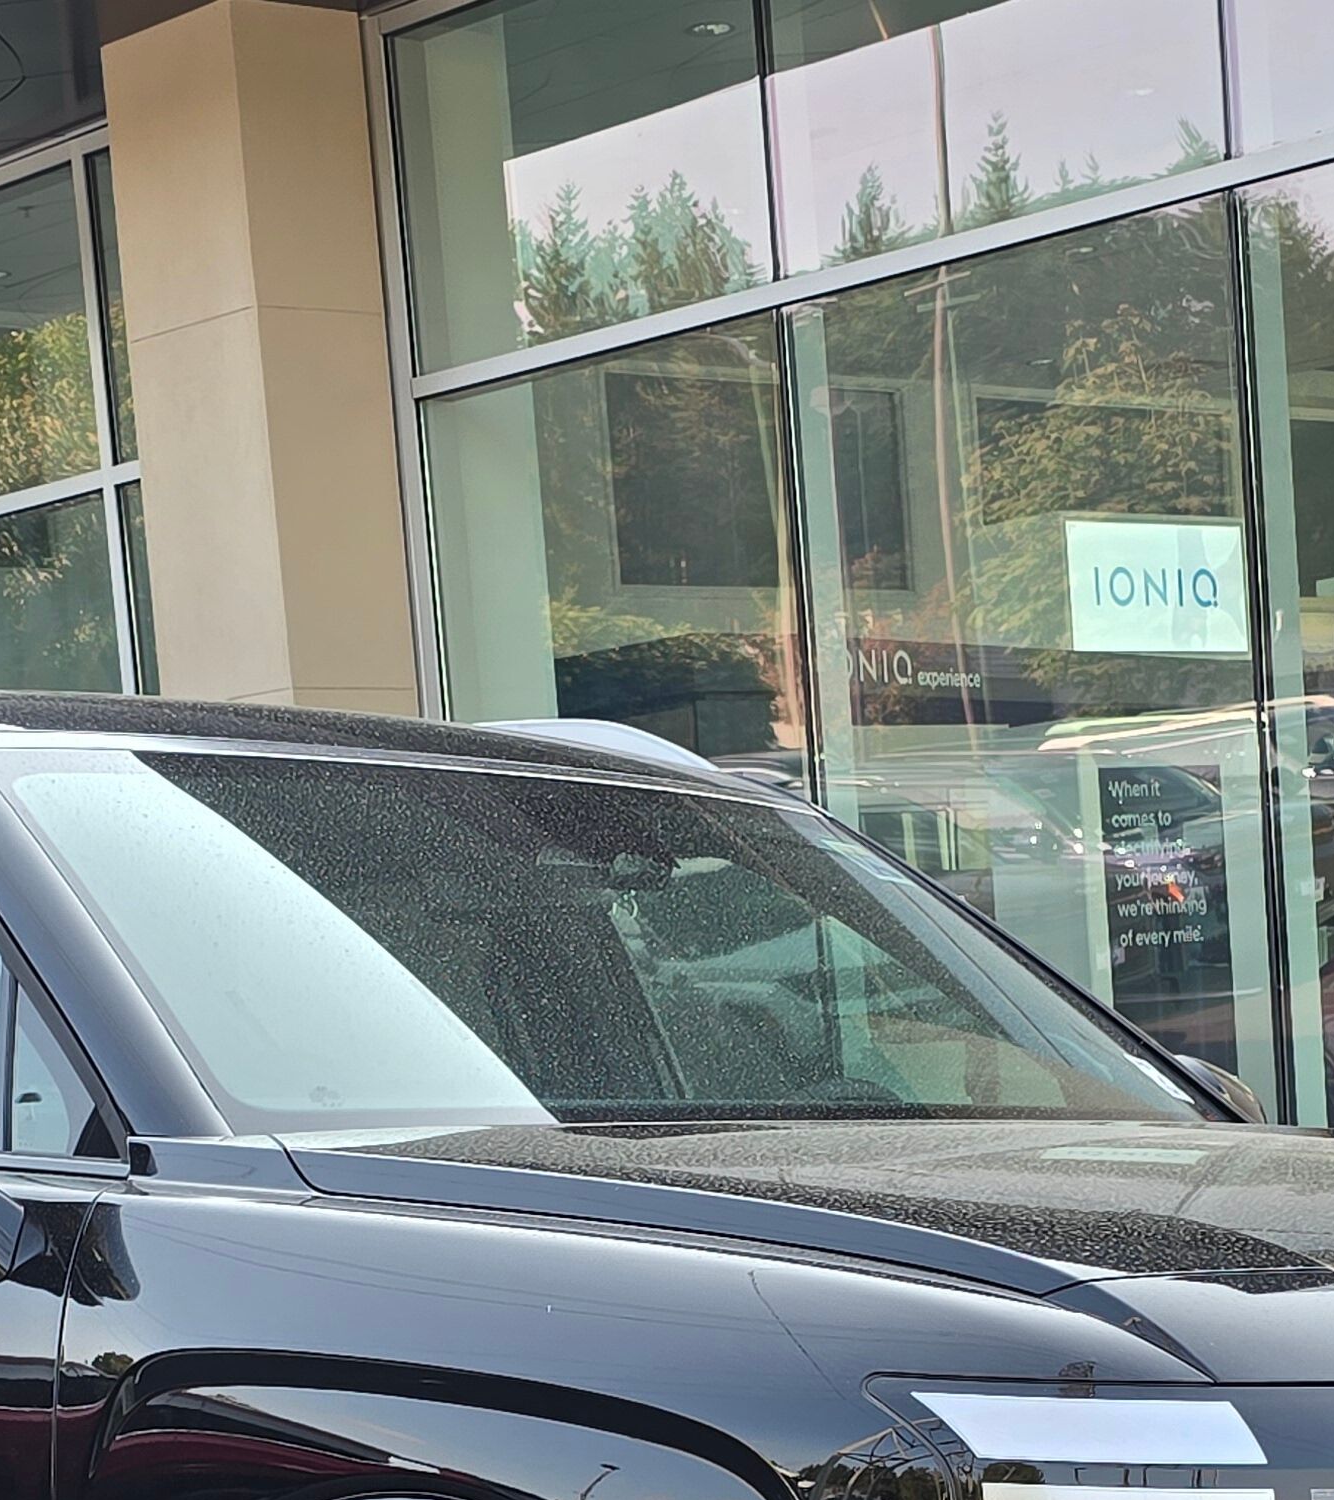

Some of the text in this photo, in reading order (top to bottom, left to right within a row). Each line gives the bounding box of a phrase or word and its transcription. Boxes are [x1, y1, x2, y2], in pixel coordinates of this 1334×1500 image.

[1094, 566, 1218, 608] IONIQ
[846, 649, 981, 690] NIQ experience
[1109, 778, 1160, 798] When it
[1111, 810, 1172, 828] comes to
[1115, 871, 1146, 891] your
[1117, 897, 1207, 917] we're thinking
[1120, 928, 1133, 947] of
[1135, 930, 1171, 948] every
